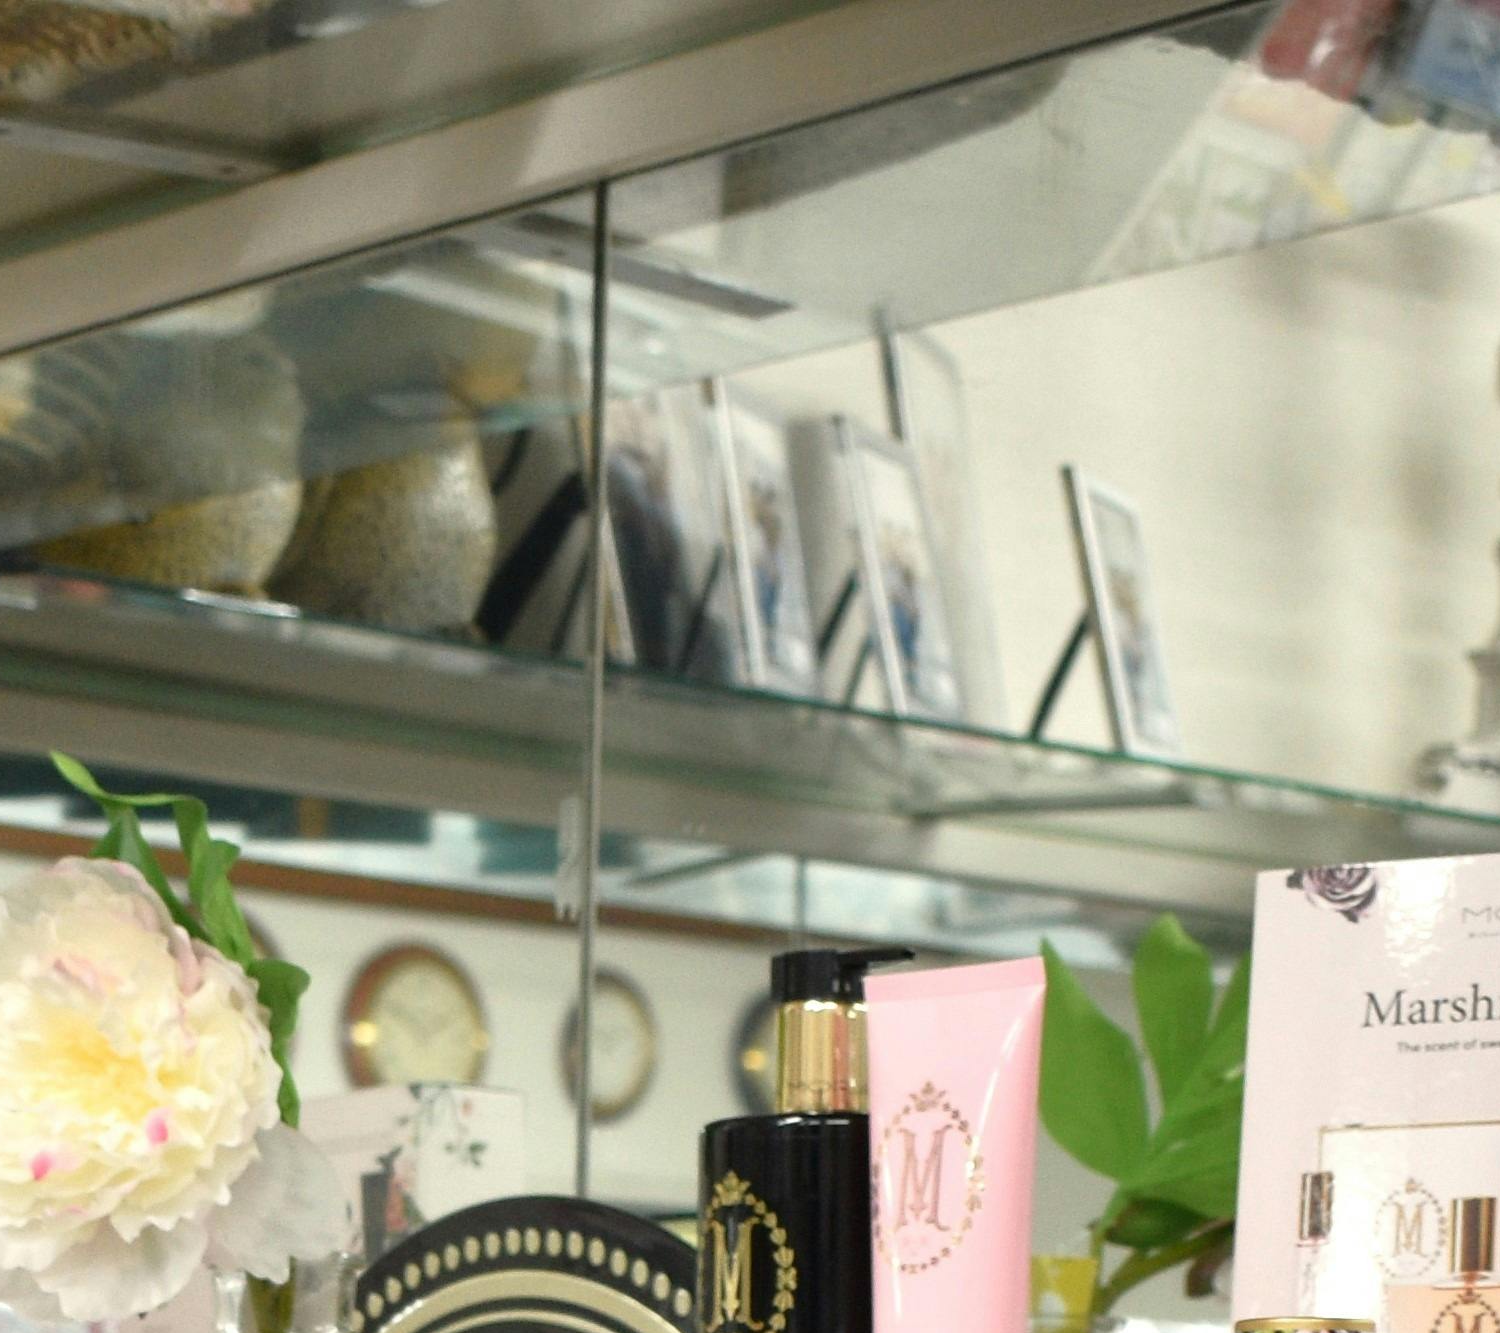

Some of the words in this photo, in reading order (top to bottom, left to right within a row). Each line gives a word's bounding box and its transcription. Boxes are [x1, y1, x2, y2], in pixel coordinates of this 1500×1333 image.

[1396, 1039, 1421, 1054] The
[1424, 1037, 1461, 1054] scent
[1463, 1036, 1479, 1051] of
